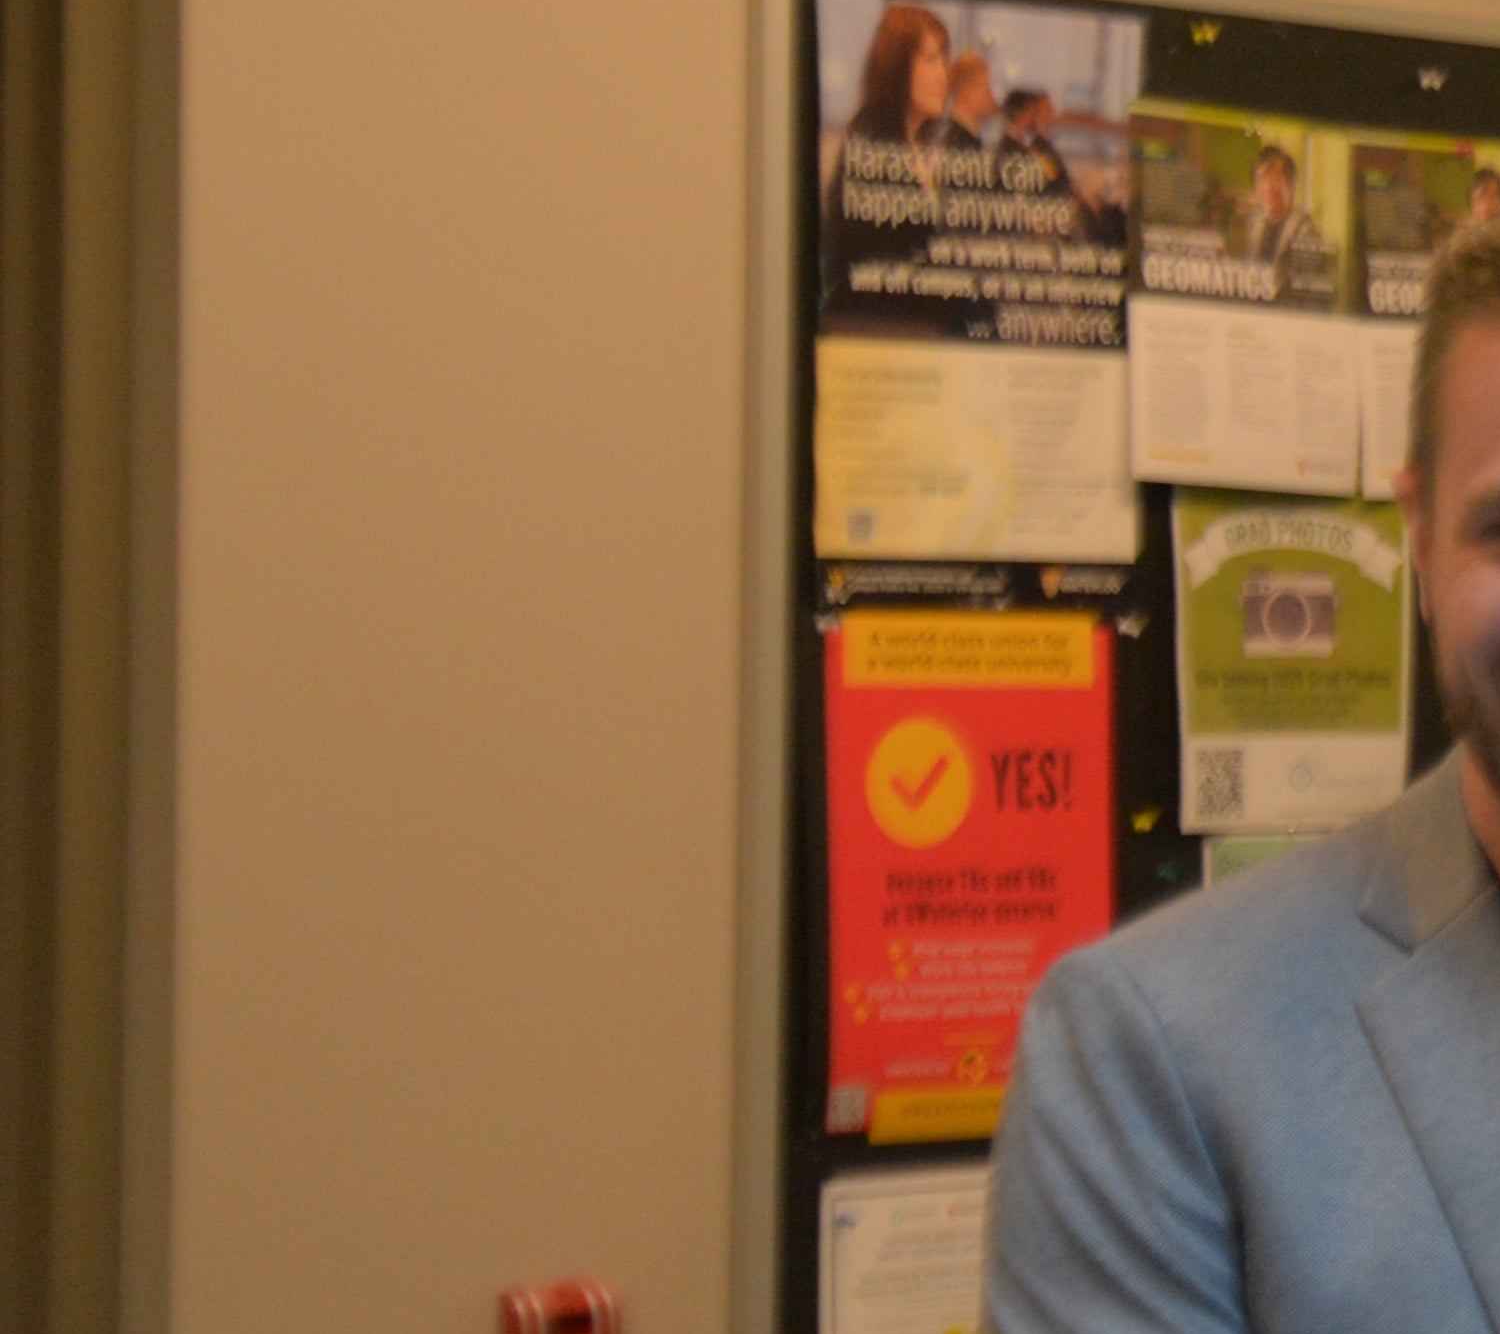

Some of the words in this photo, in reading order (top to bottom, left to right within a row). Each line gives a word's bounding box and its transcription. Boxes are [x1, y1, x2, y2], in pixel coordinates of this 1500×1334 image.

[1002, 152, 1045, 193] can
[843, 181, 938, 229] happen
[946, 191, 1071, 235] anywhere
[1141, 253, 1278, 302] GEOMATICS
[1223, 520, 1272, 551] GRAD
[1277, 519, 1355, 552] PHOTOS
[869, 633, 881, 650] A
[989, 636, 1040, 650] union
[985, 656, 1074, 677] university
[990, 749, 1074, 814] YES!
